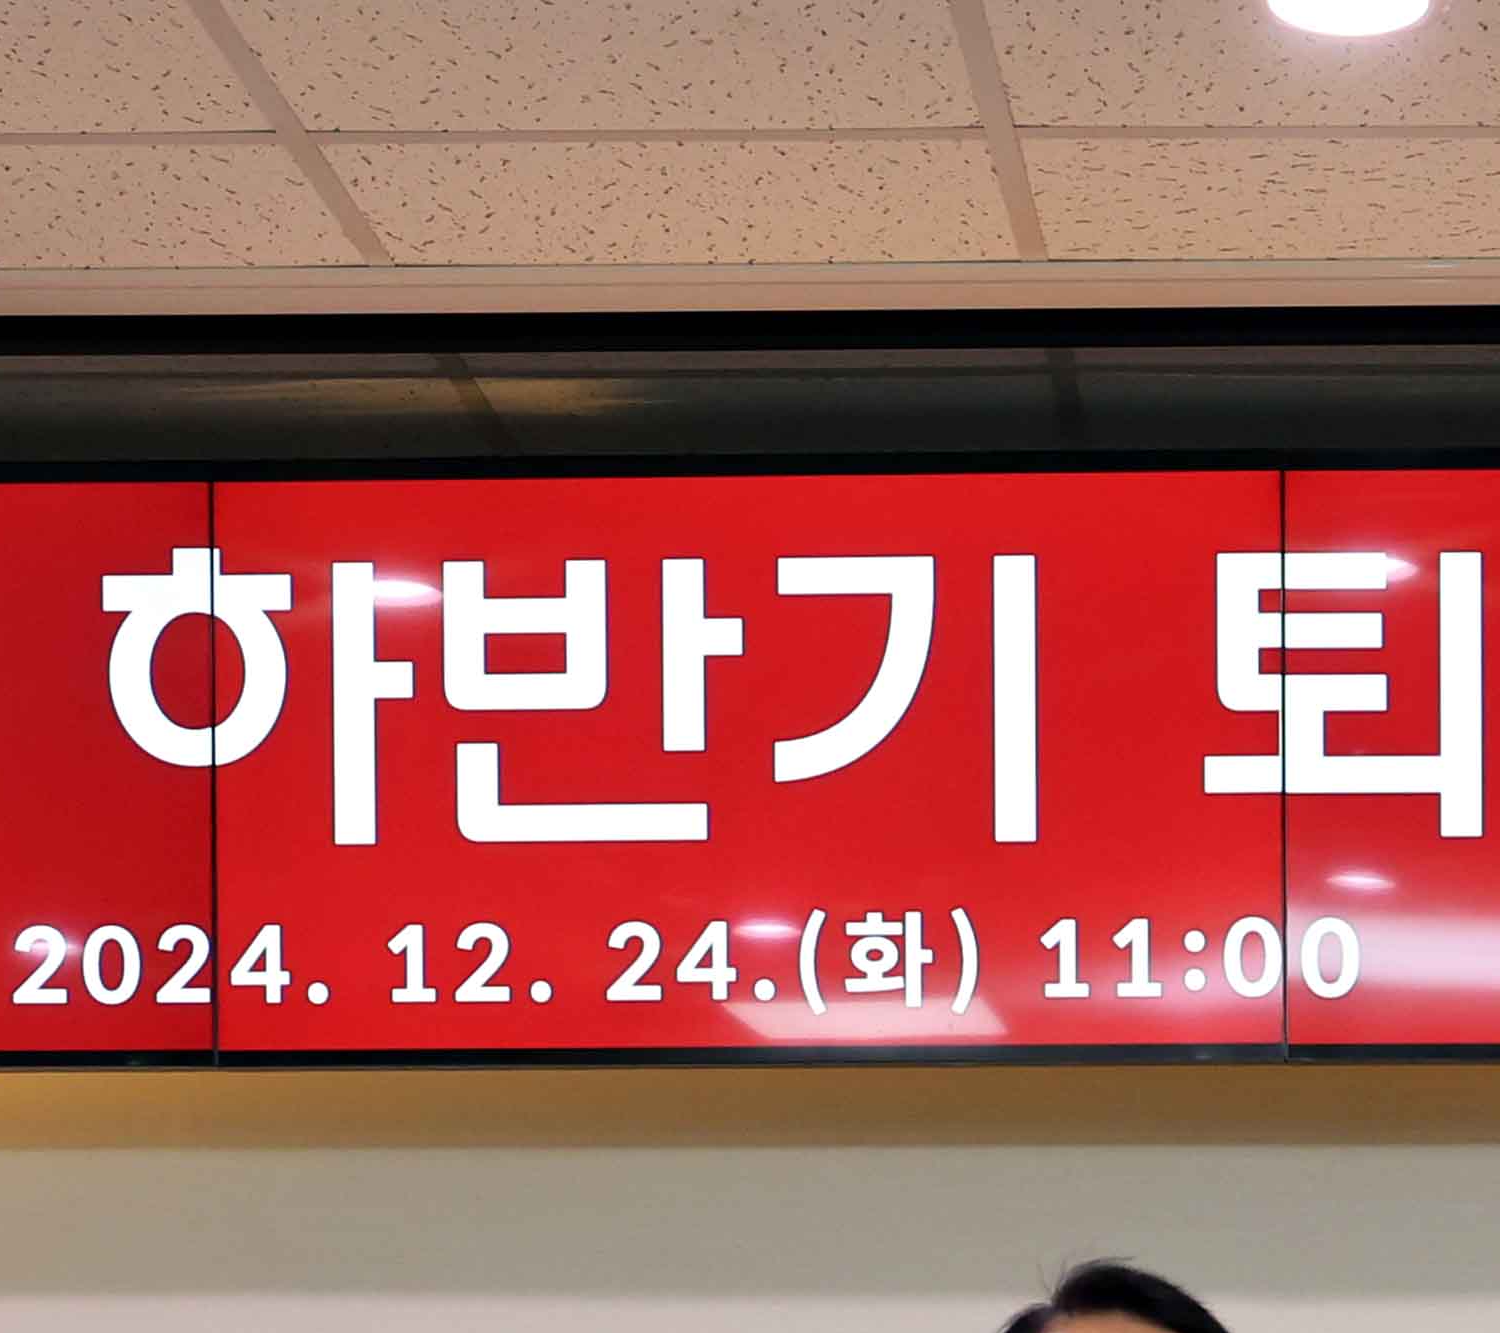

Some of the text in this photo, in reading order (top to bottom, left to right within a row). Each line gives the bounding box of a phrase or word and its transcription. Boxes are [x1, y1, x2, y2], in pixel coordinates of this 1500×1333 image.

[102, 547, 1037, 846] 하반기
[12, 924, 329, 1005] 2024.
[387, 922, 553, 1003] 12.
[1039, 916, 1362, 1000] 11:00
